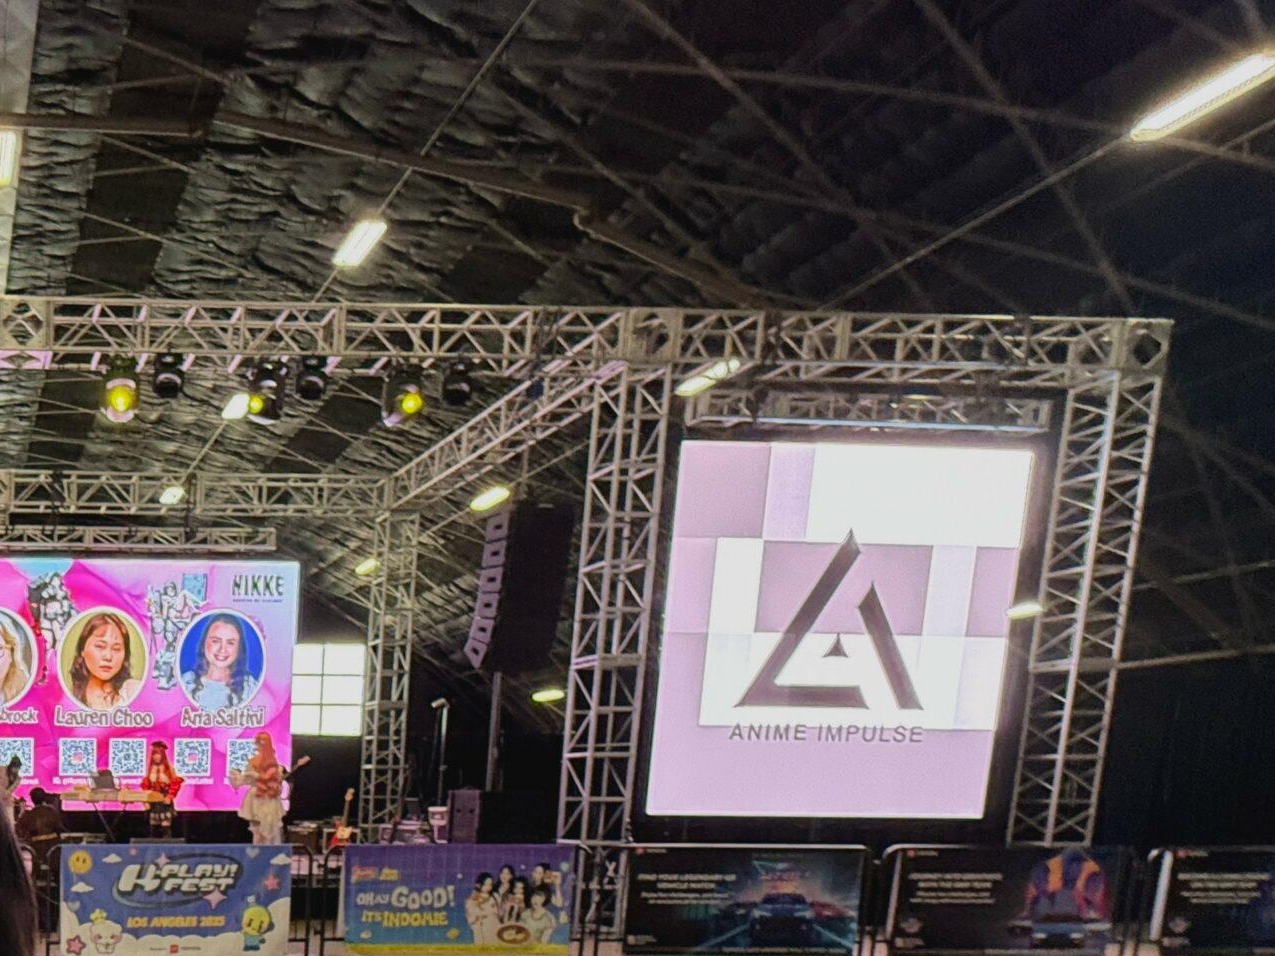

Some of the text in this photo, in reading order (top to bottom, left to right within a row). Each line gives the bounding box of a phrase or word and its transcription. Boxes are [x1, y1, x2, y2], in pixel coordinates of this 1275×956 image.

[232, 574, 284, 596] NIKKE
[55, 706, 153, 726] Lauren Choo
[182, 706, 264, 727] Aria Saltini
[728, 722, 924, 743] ANIME IMPULSE
[165, 877, 234, 892] FEST
[391, 885, 456, 909] GOOD!
[382, 911, 449, 928] INDOMIE
